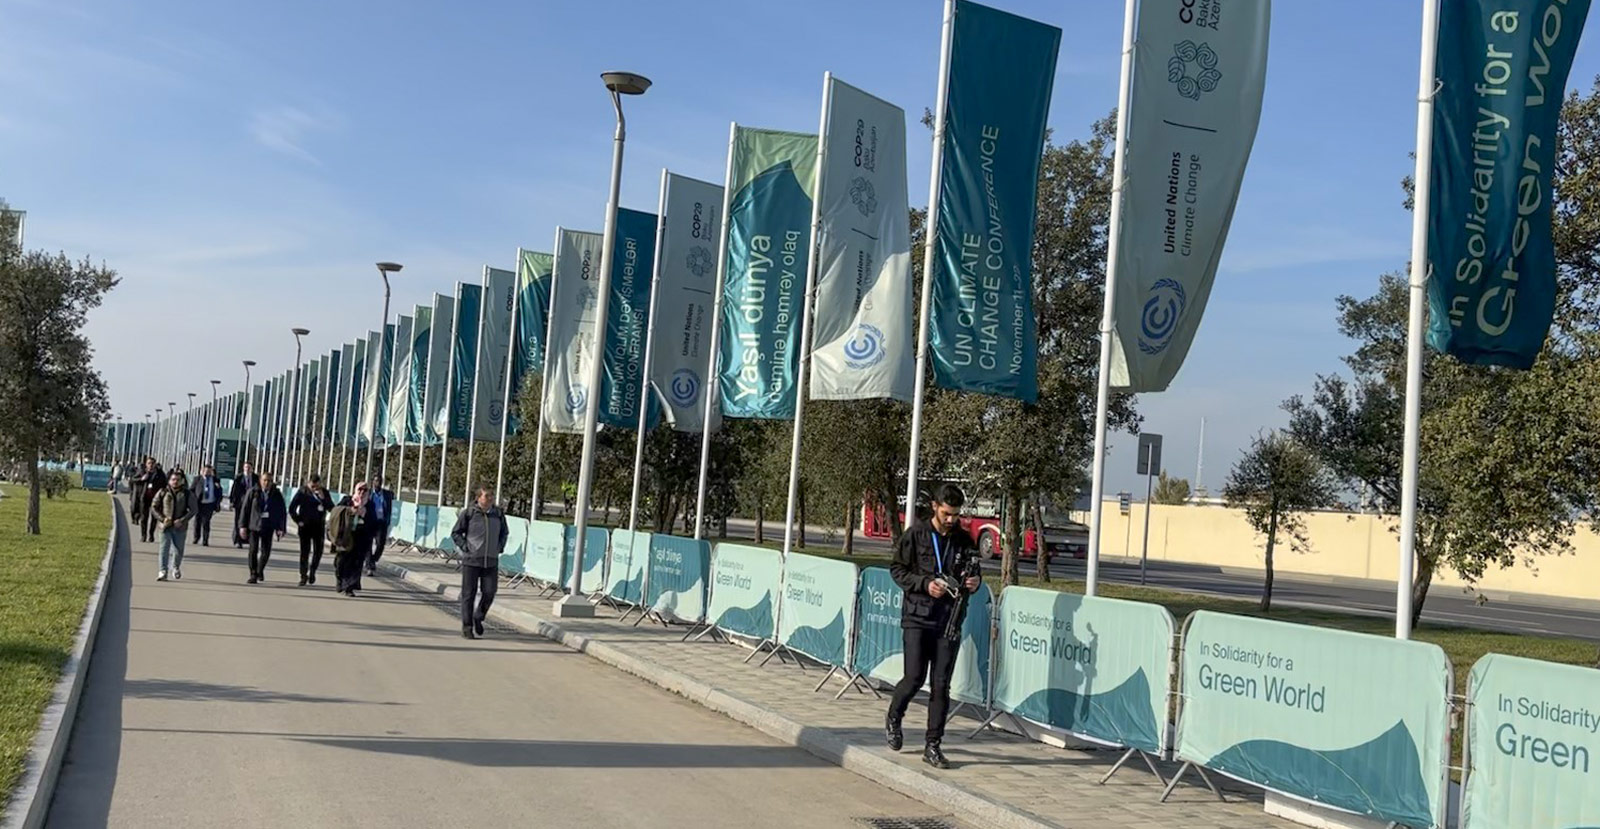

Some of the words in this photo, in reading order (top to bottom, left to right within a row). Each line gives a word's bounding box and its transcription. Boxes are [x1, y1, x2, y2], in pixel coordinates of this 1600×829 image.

[1490, 10, 1519, 34] a
[1474, 44, 1513, 97] for
[854, 118, 865, 167] COP29
[980, 124, 1003, 271] CONFERENCE
[1166, 151, 1181, 205] Nations
[1185, 154, 1201, 205] Change
[1456, 107, 1510, 285] Solidarity
[692, 202, 703, 239] COP29
[1164, 209, 1176, 254] United
[1181, 206, 1196, 257] Climate
[781, 230, 801, 266] olaq
[740, 234, 773, 324] dünya
[773, 270, 796, 335] həmrəy
[957, 233, 981, 328] CLIMATE
[979, 276, 1001, 370] CHANGE
[1009, 305, 1024, 375] November
[734, 333, 765, 401] Yaşıl
[953, 334, 973, 366] UN
[1010, 629, 1047, 656] Green
[1051, 636, 1092, 665] World
[1065, 621, 1072, 632] a
[1200, 641, 1210, 656] In
[1212, 643, 1265, 669] Solidarity
[1266, 651, 1283, 669] for
[1285, 658, 1294, 671] a
[1199, 663, 1257, 699] Green
[1264, 675, 1325, 713] World
[1498, 693, 1513, 713] In
[1517, 697, 1600, 734] Solidarity
[1495, 722, 1589, 773] Green
